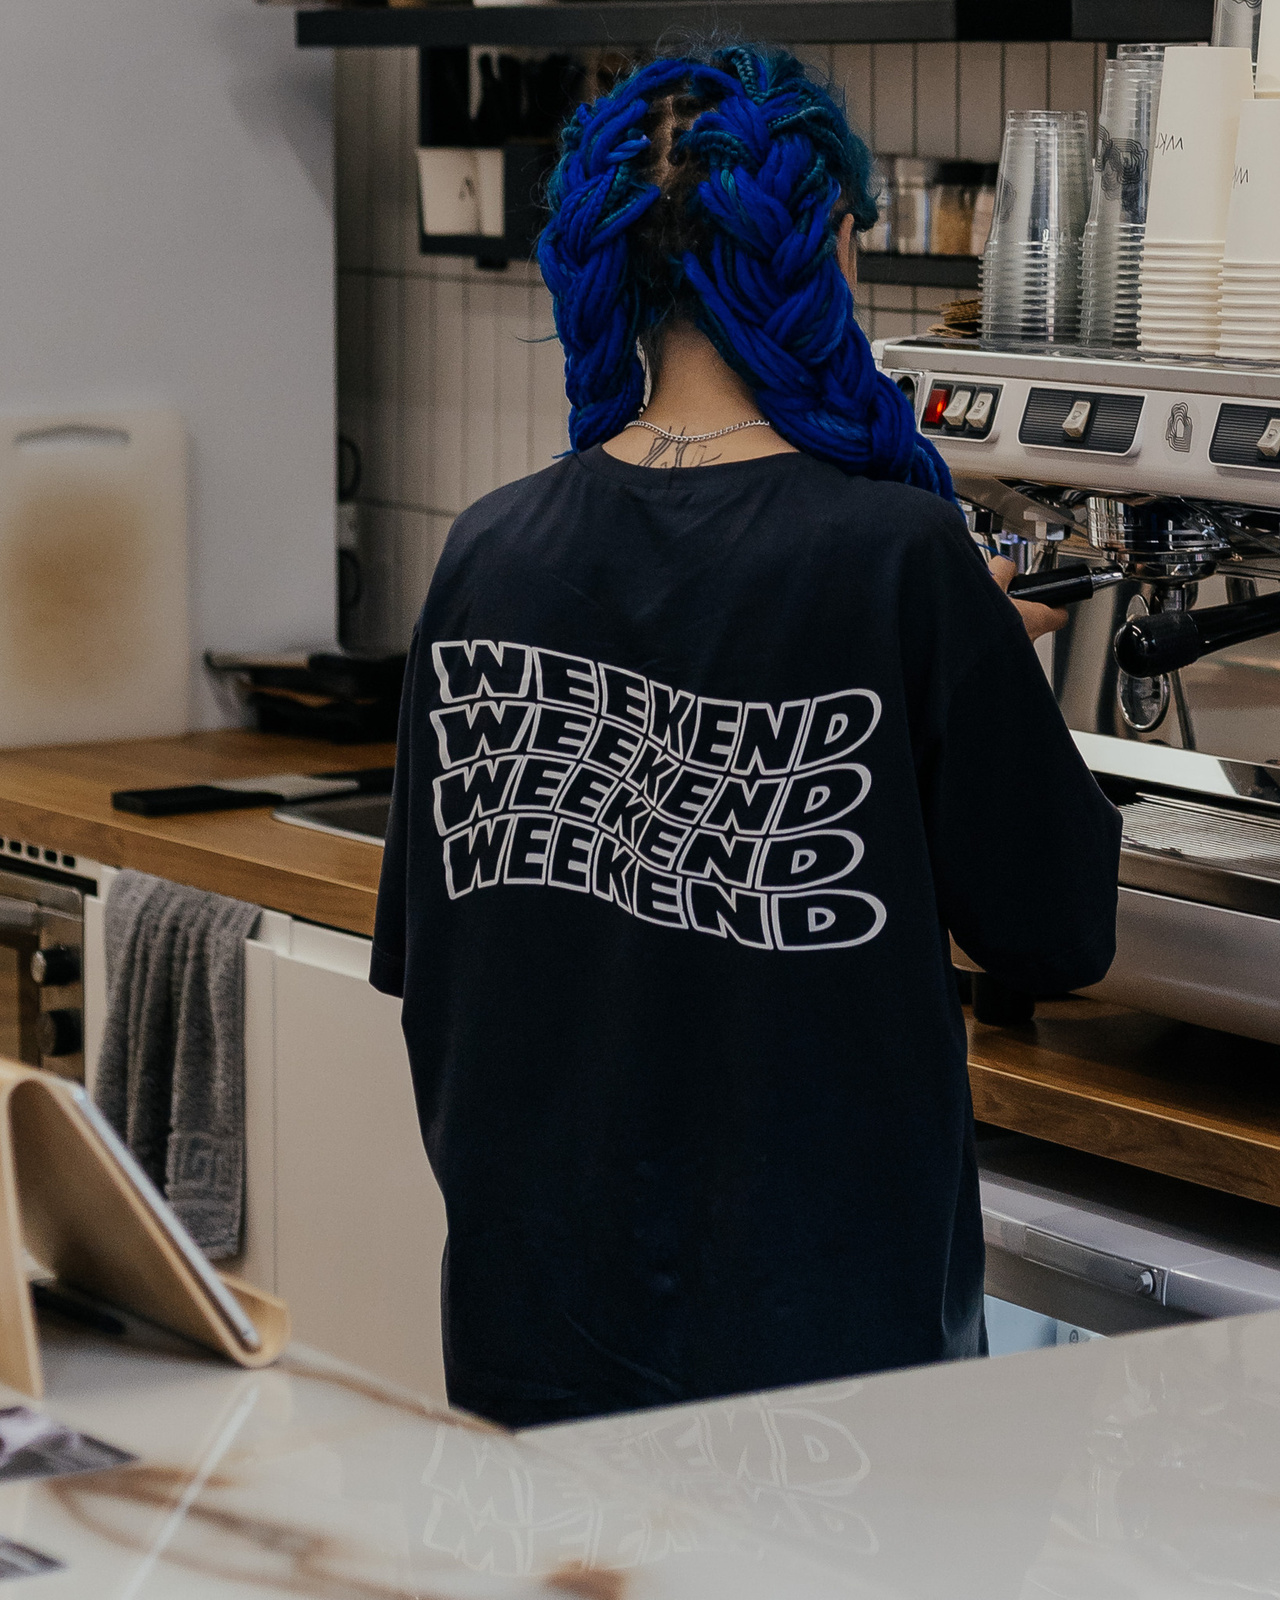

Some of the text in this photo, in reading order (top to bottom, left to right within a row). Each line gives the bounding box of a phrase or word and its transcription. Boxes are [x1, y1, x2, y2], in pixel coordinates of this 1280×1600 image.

[429, 700, 872, 835] WEEKEND
[431, 640, 883, 775] WEEKEND
[432, 754, 865, 890] WEEKEND
[443, 812, 887, 951] WEEKEND
